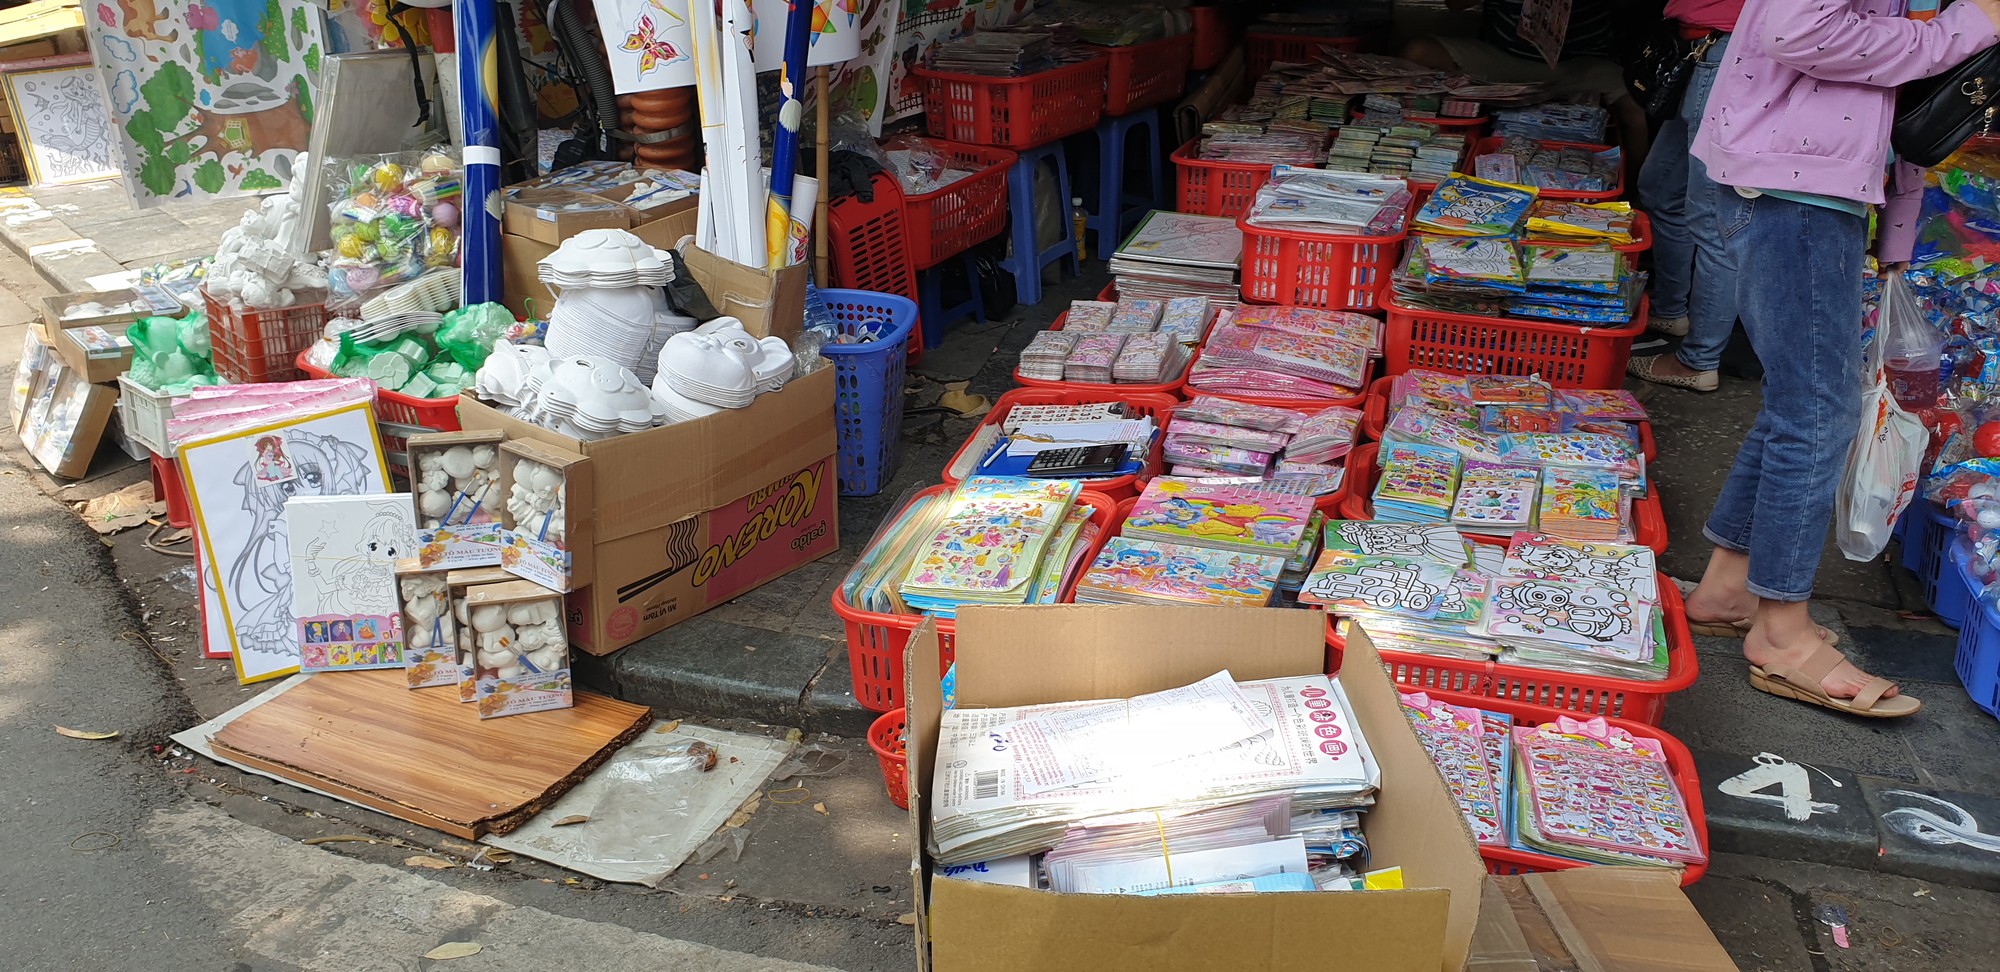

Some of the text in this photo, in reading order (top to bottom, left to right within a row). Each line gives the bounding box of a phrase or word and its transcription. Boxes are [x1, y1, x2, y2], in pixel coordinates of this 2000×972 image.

[692, 461, 825, 588] KORENO
[747, 475, 793, 513] UMBO
[790, 520, 827, 552] paldo
[1301, 688, 1346, 755] 儿童涂色画
[1717, 752, 1841, 822] 4
